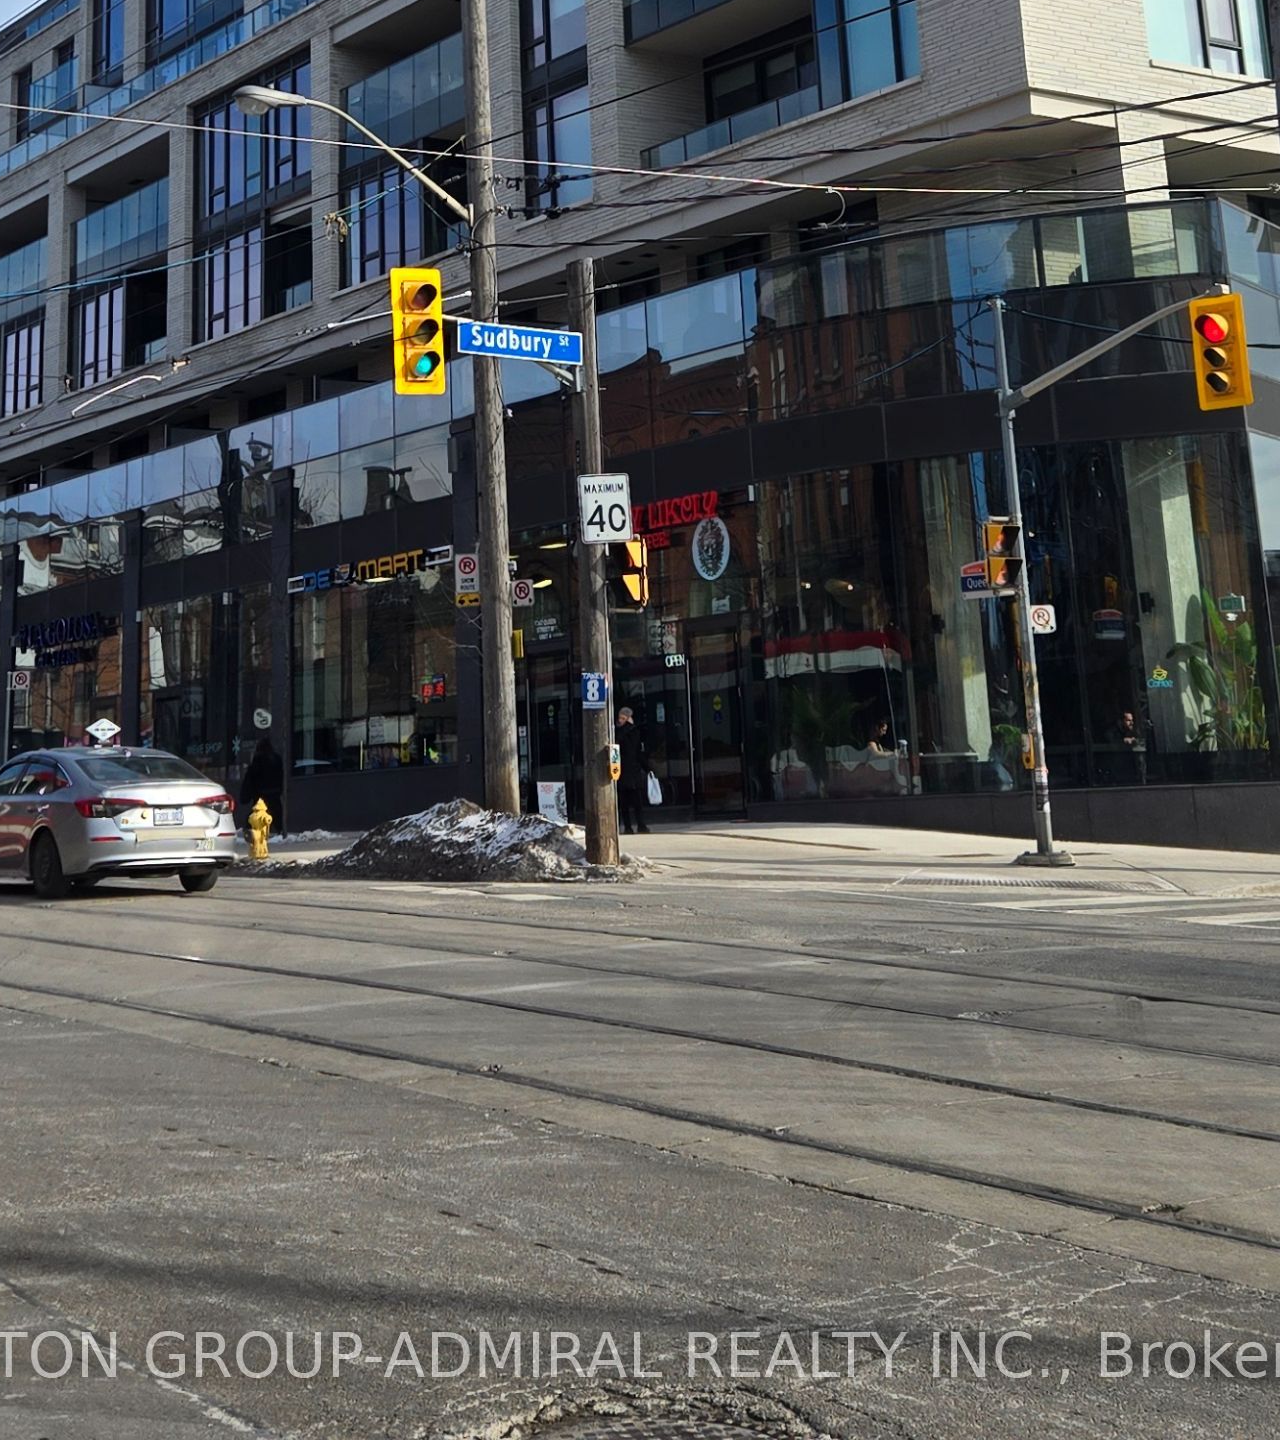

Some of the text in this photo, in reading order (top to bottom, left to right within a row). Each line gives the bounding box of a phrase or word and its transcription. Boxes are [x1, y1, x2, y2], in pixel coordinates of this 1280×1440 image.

[471, 325, 569, 358] Sudbury St
[583, 483, 624, 495] MAXIMUM
[586, 503, 627, 533] 40
[665, 654, 686, 668] OPEN
[586, 679, 600, 702] 8
